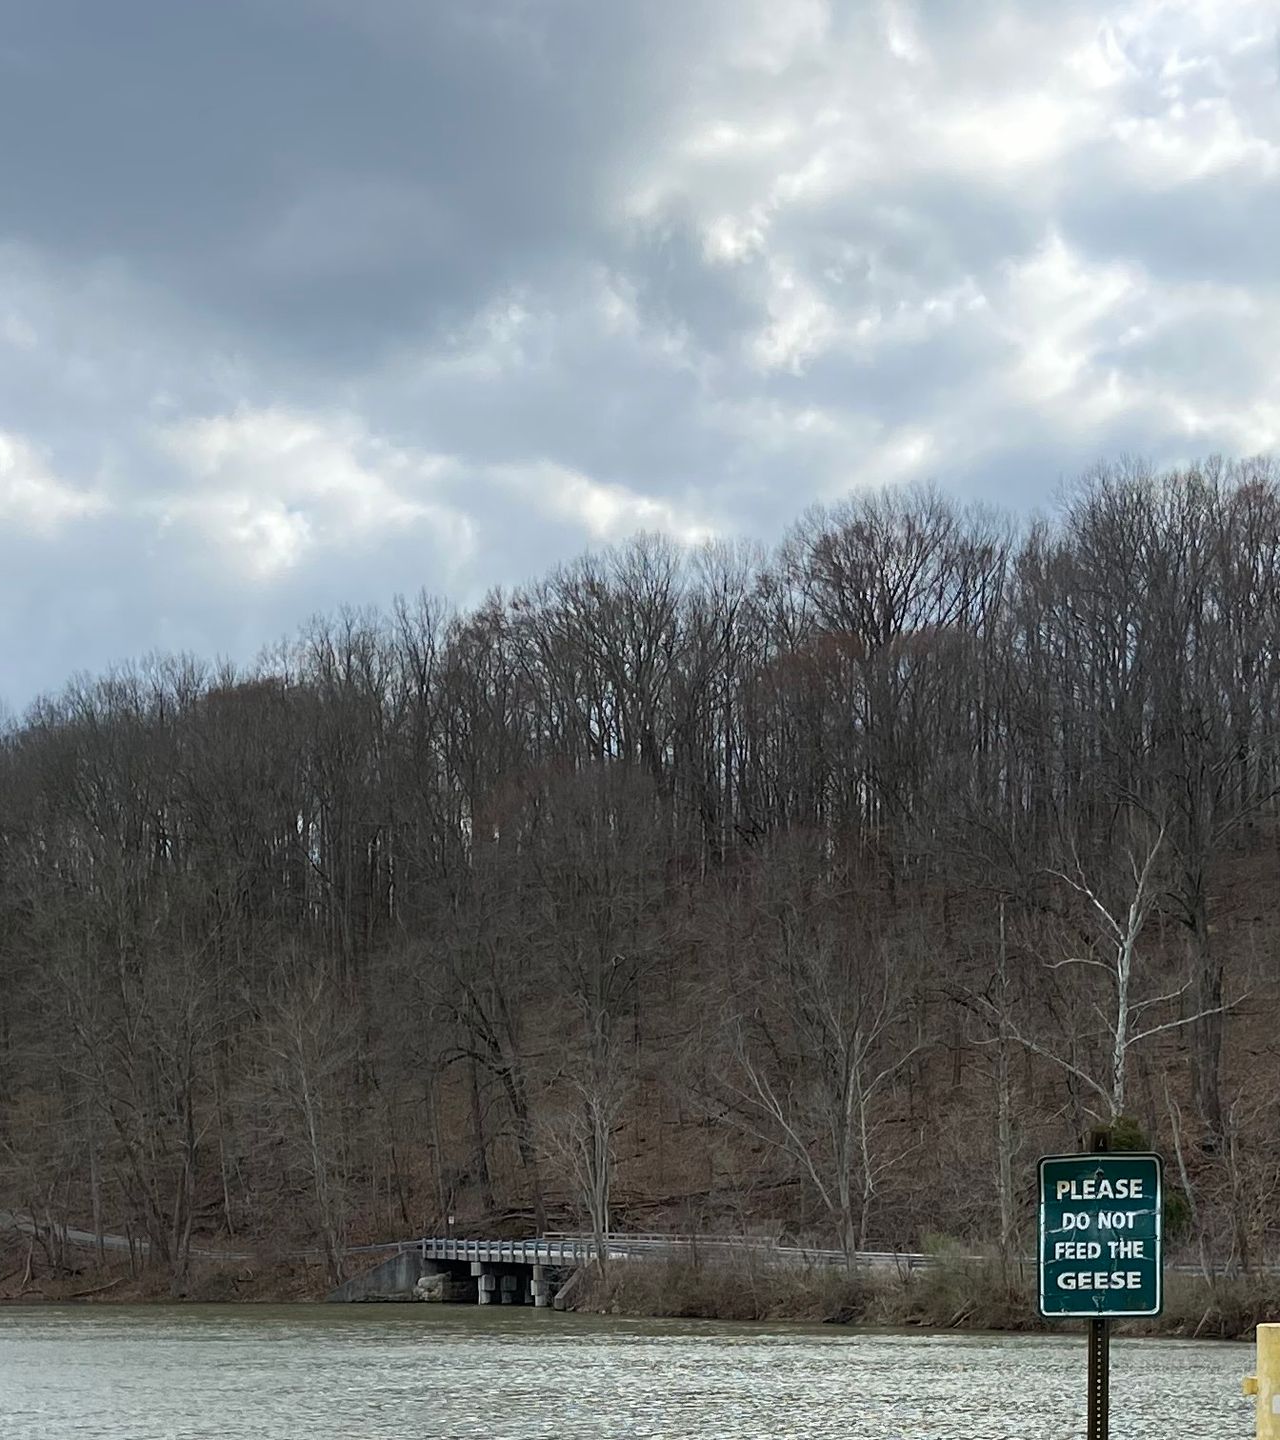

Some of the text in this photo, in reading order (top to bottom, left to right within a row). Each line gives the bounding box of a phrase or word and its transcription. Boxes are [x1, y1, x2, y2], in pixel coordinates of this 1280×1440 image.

[1056, 1179, 1143, 1199] PLEASE
[1062, 1212, 1134, 1230] DO NOT
[1055, 1241, 1144, 1259] FEED THE
[1057, 1272, 1142, 1290] GEESE
